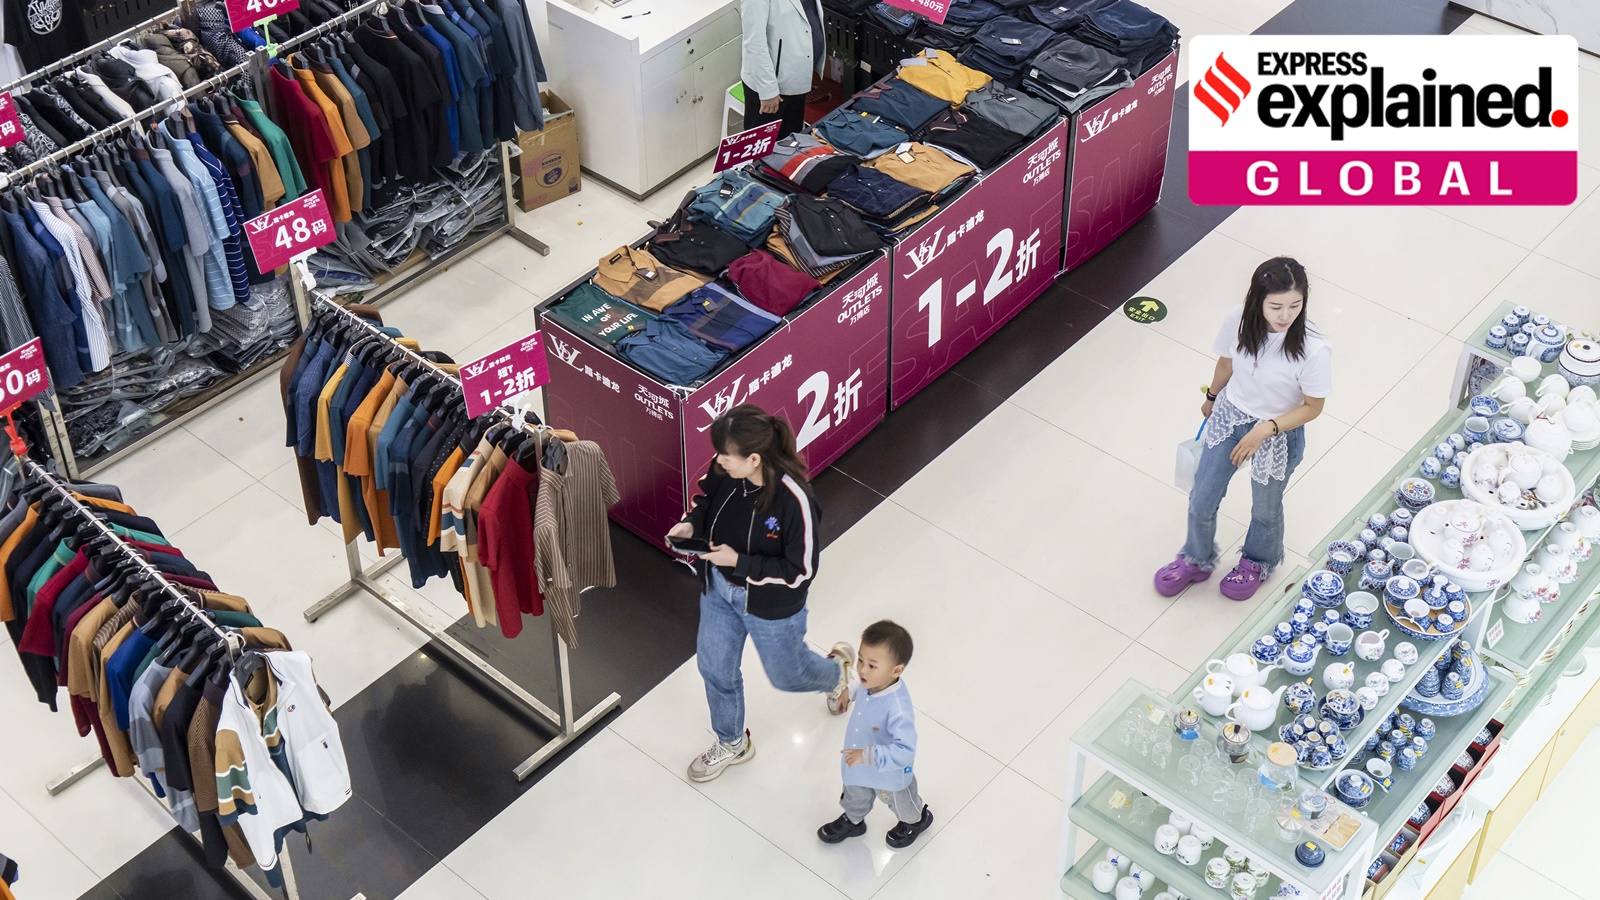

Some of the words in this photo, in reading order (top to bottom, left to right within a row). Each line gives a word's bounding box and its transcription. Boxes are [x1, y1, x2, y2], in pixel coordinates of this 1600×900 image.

[1147, 72, 1173, 95] OUTLETS
[722, 136, 772, 164] 1-2折
[1027, 137, 1059, 170] 天河城
[1023, 149, 1061, 184] OUTLETS
[275, 217, 327, 249] 48码
[842, 272, 879, 309] 天河城
[918, 227, 1041, 348] 1-2折
[581, 313, 593, 323] IN
[592, 302, 612, 317] AWE
[600, 313, 612, 322] OF
[837, 285, 882, 323] OUTLETS
[598, 322, 622, 337] YOUR
[620, 312, 639, 325] LIFE
[480, 366, 536, 405] 1-2折
[638, 384, 670, 409] 天河城
[634, 393, 674, 419] OUTLETS
